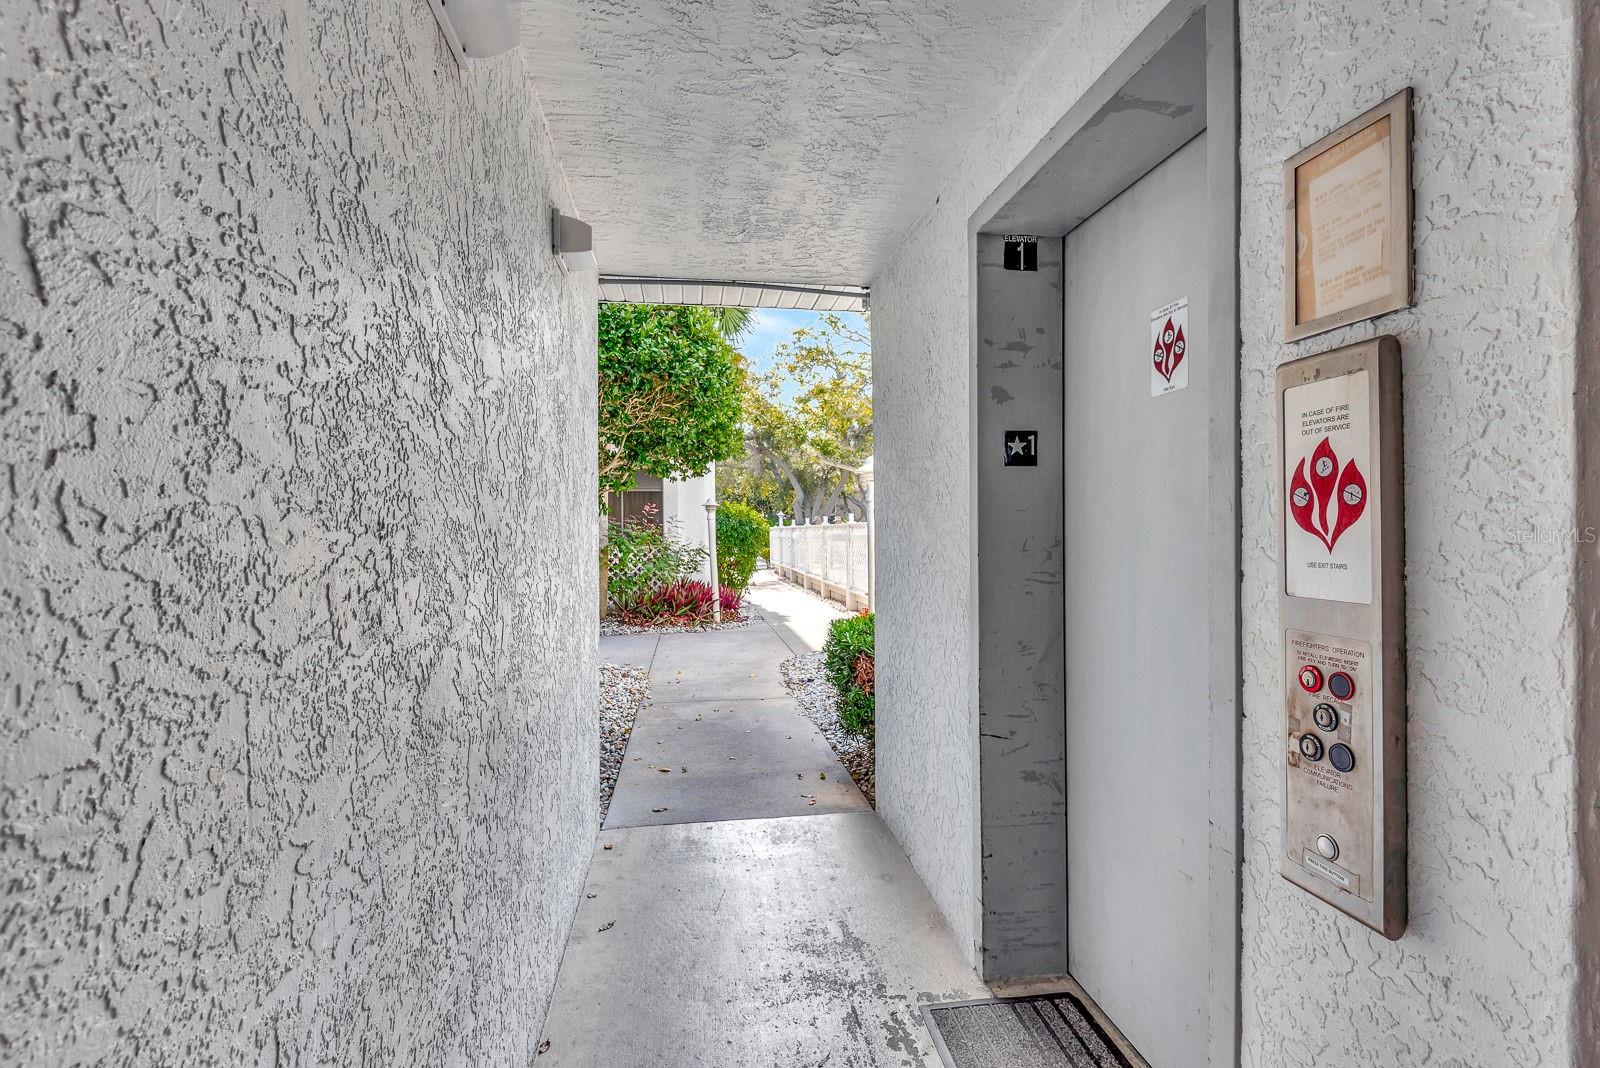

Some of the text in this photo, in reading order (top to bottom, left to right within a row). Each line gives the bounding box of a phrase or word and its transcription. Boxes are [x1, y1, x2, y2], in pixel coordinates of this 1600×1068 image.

[1004, 234, 1037, 243] ELEVATOR
[1017, 242, 1024, 270] 1
[1309, 408, 1325, 417] CASE
[1326, 406, 1335, 414] OF
[1336, 403, 1350, 412] FIRE
[1302, 413, 1350, 428] ELEVATORS ARE
[1324, 422, 1351, 433] SERVICE
[1028, 435, 1035, 456] 1
[1307, 561, 1317, 569] USE
[1329, 562, 1348, 570] STAIRS
[1332, 646, 1365, 659] OPERATION
[1328, 661, 1340, 669] TURN
[1344, 659, 1360, 667] INSERT
[1313, 763, 1341, 778] ELEVATOR
[1316, 779, 1339, 793] FAILURE
[1319, 864, 1328, 872] THIS
[1328, 869, 1345, 882] BUTTON
